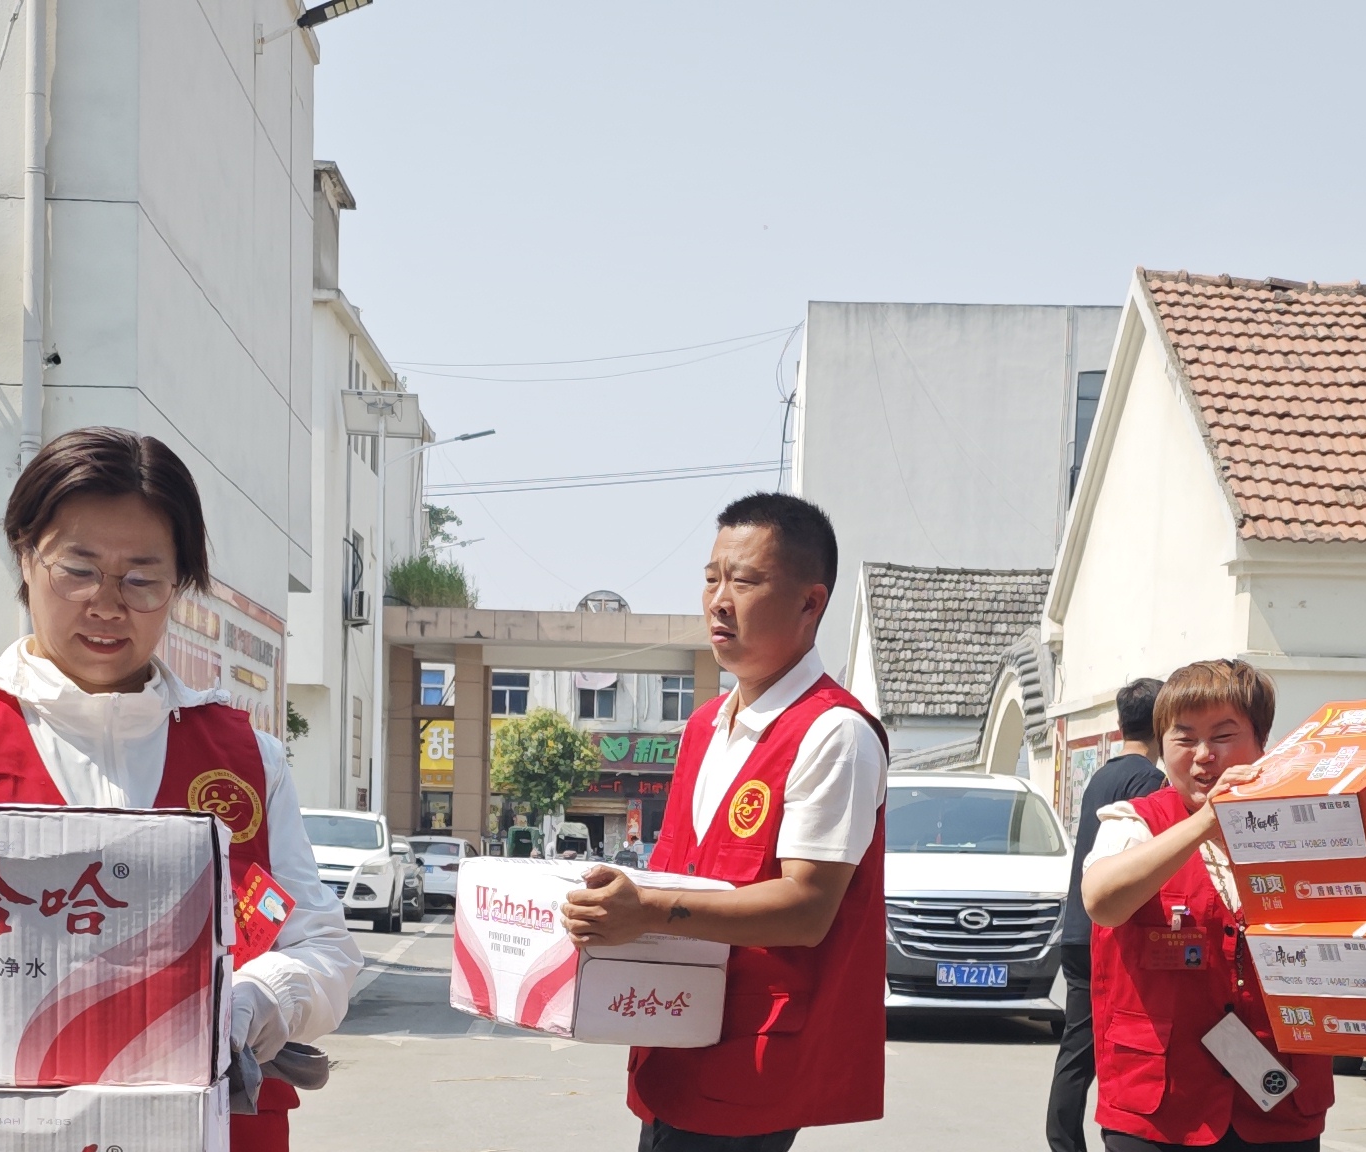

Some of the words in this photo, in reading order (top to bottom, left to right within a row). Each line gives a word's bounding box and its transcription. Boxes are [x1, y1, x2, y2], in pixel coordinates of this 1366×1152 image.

[1249, 874, 1285, 894] 劲爽
[475, 885, 555, 933] Wahaha
[607, 987, 690, 1018] 娃哈哈
[1279, 1006, 1315, 1026] 劲爽
